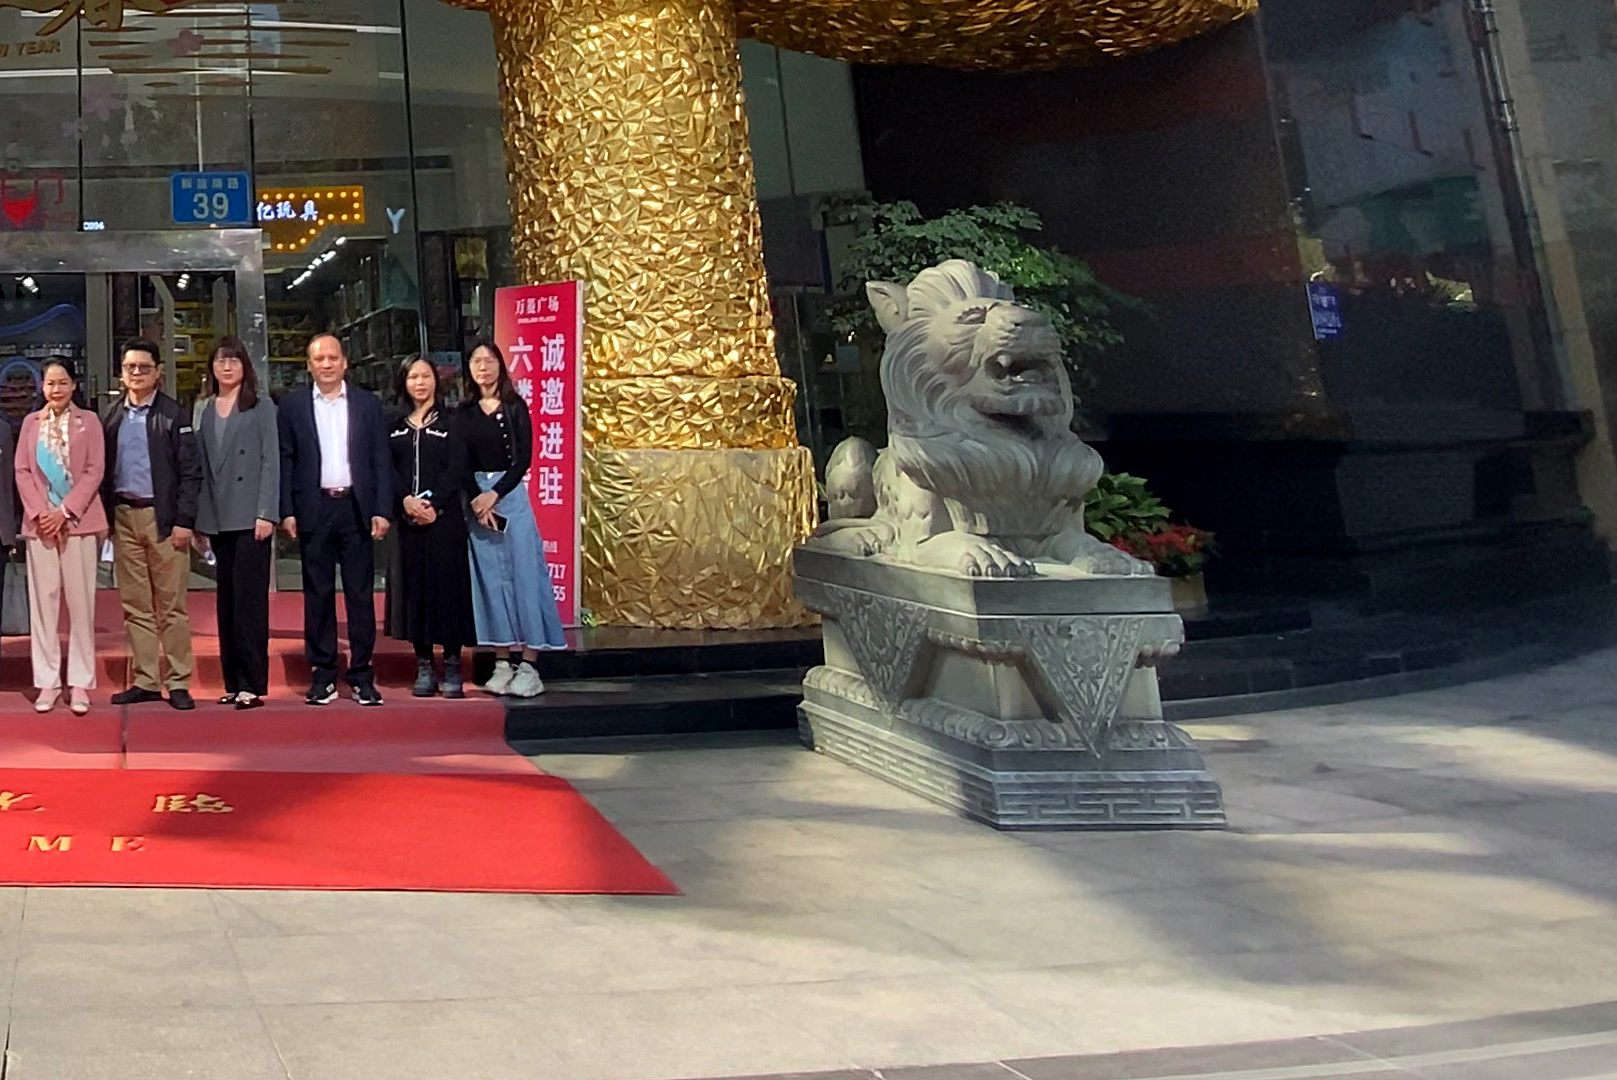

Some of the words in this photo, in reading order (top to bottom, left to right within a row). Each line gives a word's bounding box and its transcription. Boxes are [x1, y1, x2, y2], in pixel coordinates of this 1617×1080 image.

[15, 38, 61, 57] YEAR
[192, 192, 229, 219] 39
[538, 333, 566, 505] 诚邀进驻
